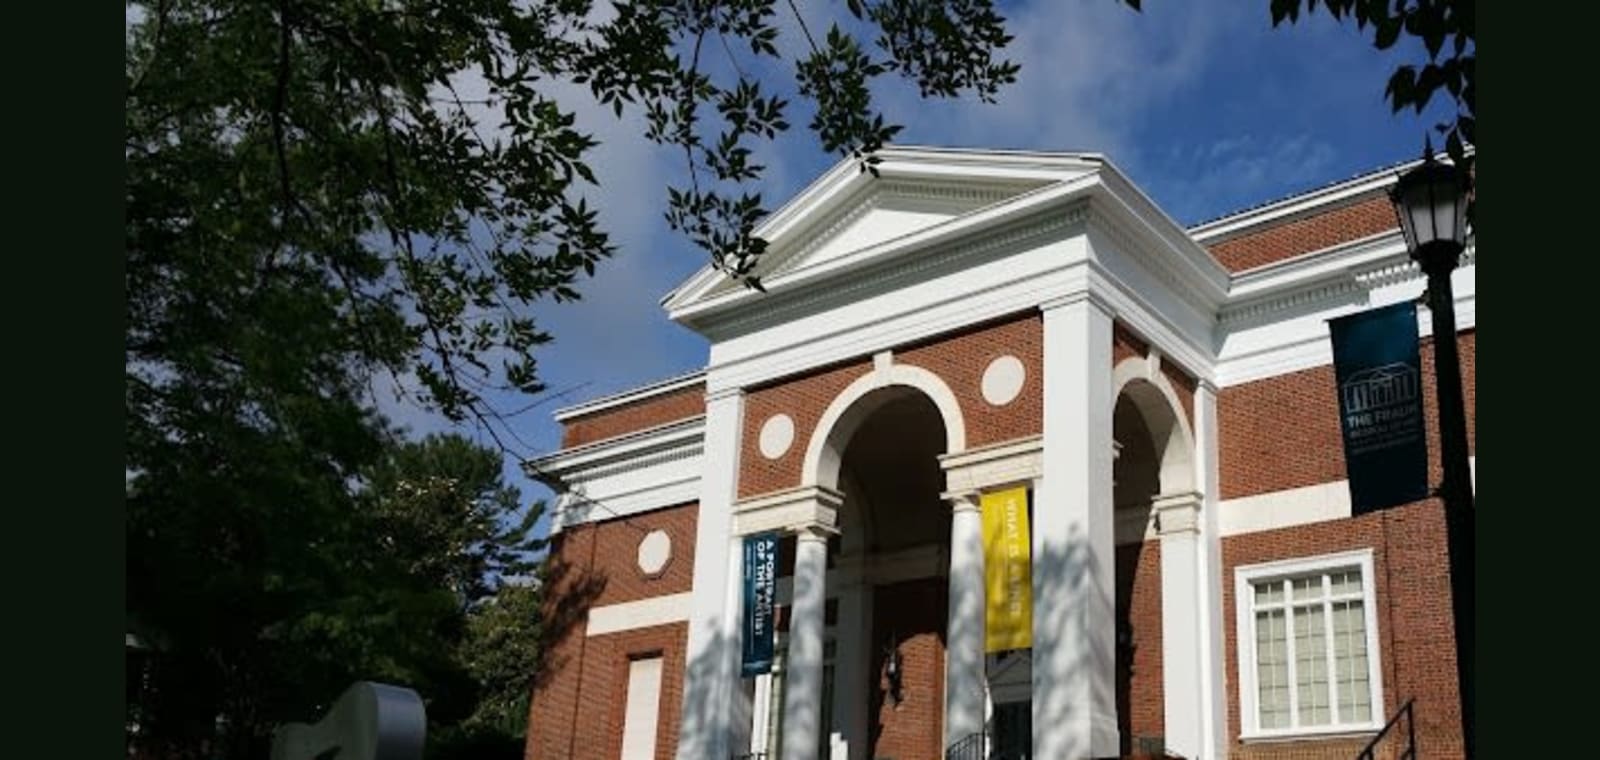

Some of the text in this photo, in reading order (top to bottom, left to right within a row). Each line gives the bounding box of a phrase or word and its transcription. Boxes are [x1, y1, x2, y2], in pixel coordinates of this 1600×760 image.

[1007, 498, 1018, 540] WHAT
[754, 541, 766, 636] OF THE ARTIST
[764, 540, 775, 616] A PORTRAIT
